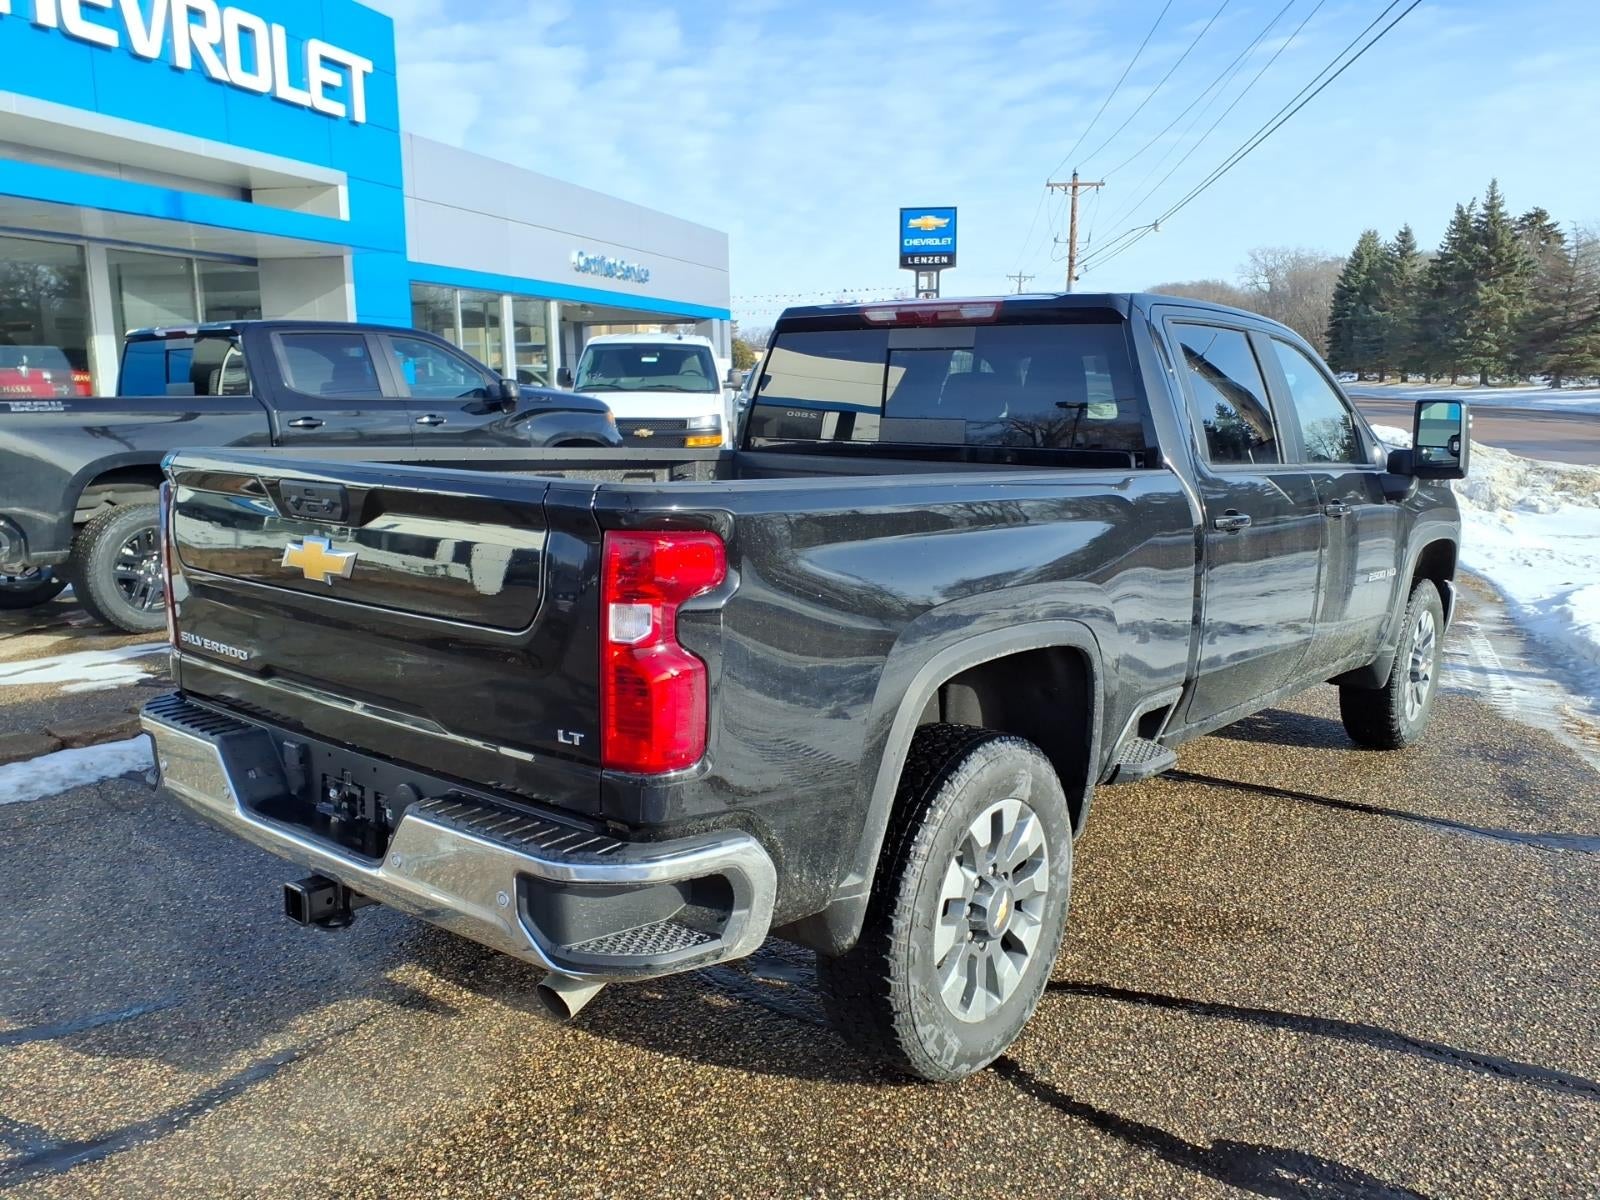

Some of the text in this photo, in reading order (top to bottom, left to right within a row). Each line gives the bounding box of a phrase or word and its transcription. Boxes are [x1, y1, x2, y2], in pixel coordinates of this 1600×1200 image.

[0, 0, 374, 124] EVROLET
[904, 237, 953, 246] CHEVROLET
[572, 250, 650, 284] Certified Service
[907, 256, 948, 264] LENZEN
[1368, 569, 1387, 582] 2500
[181, 631, 248, 660] SILVERADO
[557, 729, 585, 746] LT
